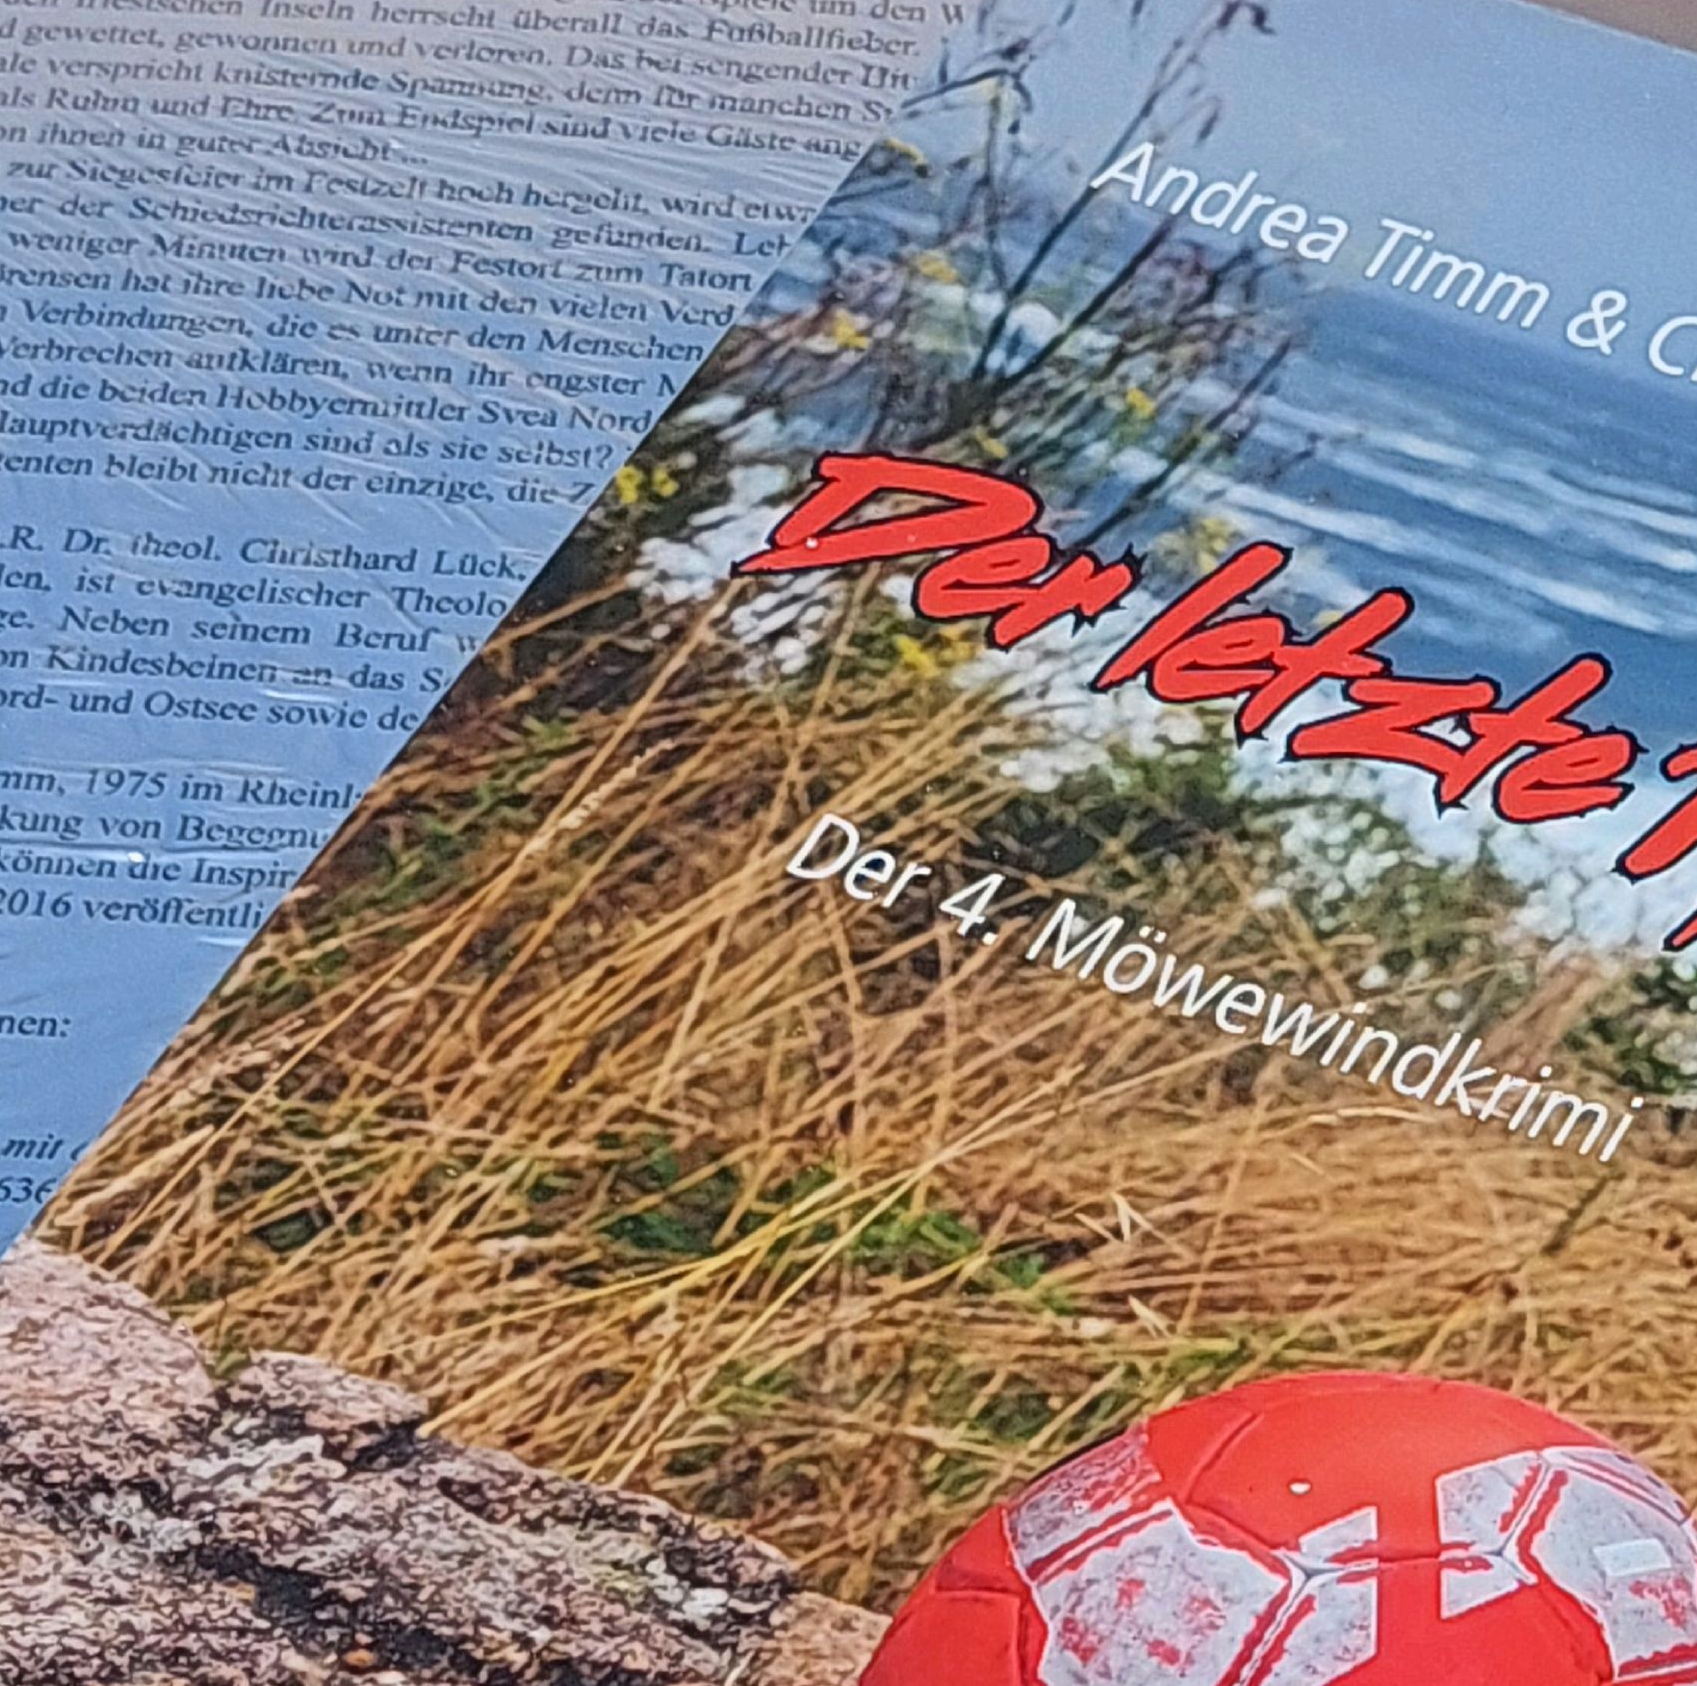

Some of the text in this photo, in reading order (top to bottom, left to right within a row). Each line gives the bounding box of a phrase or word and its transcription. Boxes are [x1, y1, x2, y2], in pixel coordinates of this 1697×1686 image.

[1090, 141, 1350, 264] Andrea
[1364, 217, 1552, 328] Timm
[1565, 289, 1628, 355] &
[120, 267, 172, 293] hat
[342, 281, 406, 307] Not
[414, 290, 468, 311] mit
[478, 289, 537, 314] den
[548, 293, 646, 321] vielen
[265, 313, 318, 339] die
[372, 324, 460, 346] unter
[466, 326, 526, 351] den
[537, 329, 703, 361] Menschen
[38, 374, 90, 400] die
[98, 378, 207, 406] beiden
[477, 400, 557, 428] Svea
[366, 362, 452, 384] wenn
[467, 361, 512, 387] ihr
[525, 371, 646, 398] engster
[302, 429, 375, 454] sind
[382, 433, 430, 458] als
[439, 436, 488, 461] sie
[497, 440, 613, 469] selbst?
[104, 453, 197, 482] bleibt
[207, 461, 292, 488] nicht
[301, 465, 357, 491] der
[365, 471, 494, 504] einzige,
[506, 477, 559, 504] die
[63, 528, 111, 555] Dr.
[239, 537, 417, 572] Christhard
[74, 566, 115, 593] ist
[136, 577, 370, 608] evangelischer
[57, 605, 169, 636] Neben
[335, 622, 441, 652] Beruf
[730, 451, 1145, 653] Der
[1089, 541, 1648, 824] letzte
[47, 644, 277, 682] Kindesbeinen
[348, 662, 404, 691] das
[69, 688, 133, 714] und
[143, 690, 257, 722] Ostsee
[266, 700, 367, 728] sowie
[87, 768, 167, 799] 1975
[180, 773, 223, 802] im
[237, 779, 361, 813] Rheinl
[99, 817, 161, 839] von
[127, 852, 181, 882] die
[785, 811, 1645, 1163] Der 4. Möwewindkrimi
[1, 1133, 64, 1160] mit
